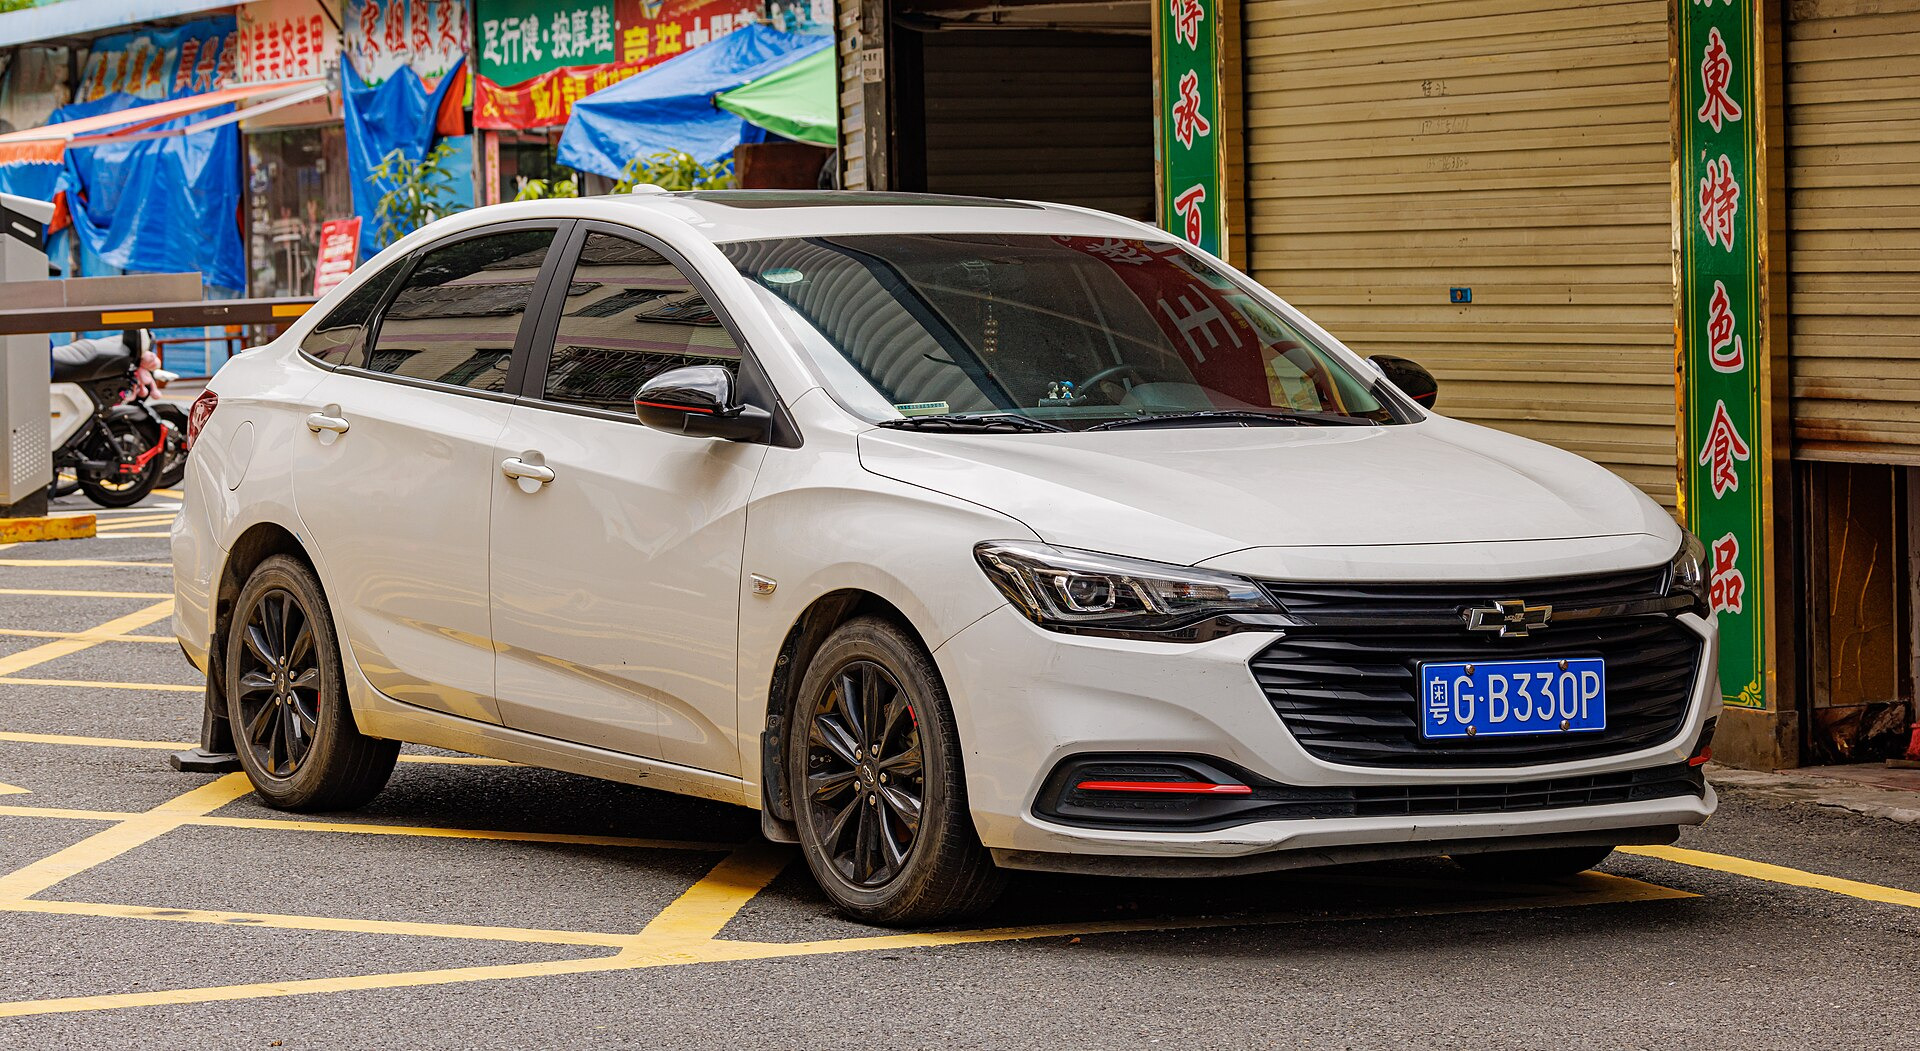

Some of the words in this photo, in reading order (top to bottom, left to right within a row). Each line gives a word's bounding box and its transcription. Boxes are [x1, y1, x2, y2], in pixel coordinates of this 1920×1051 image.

[1698, 0, 1750, 613] 東特色食品
[1429, 671, 1601, 725] 粤G·B330P
